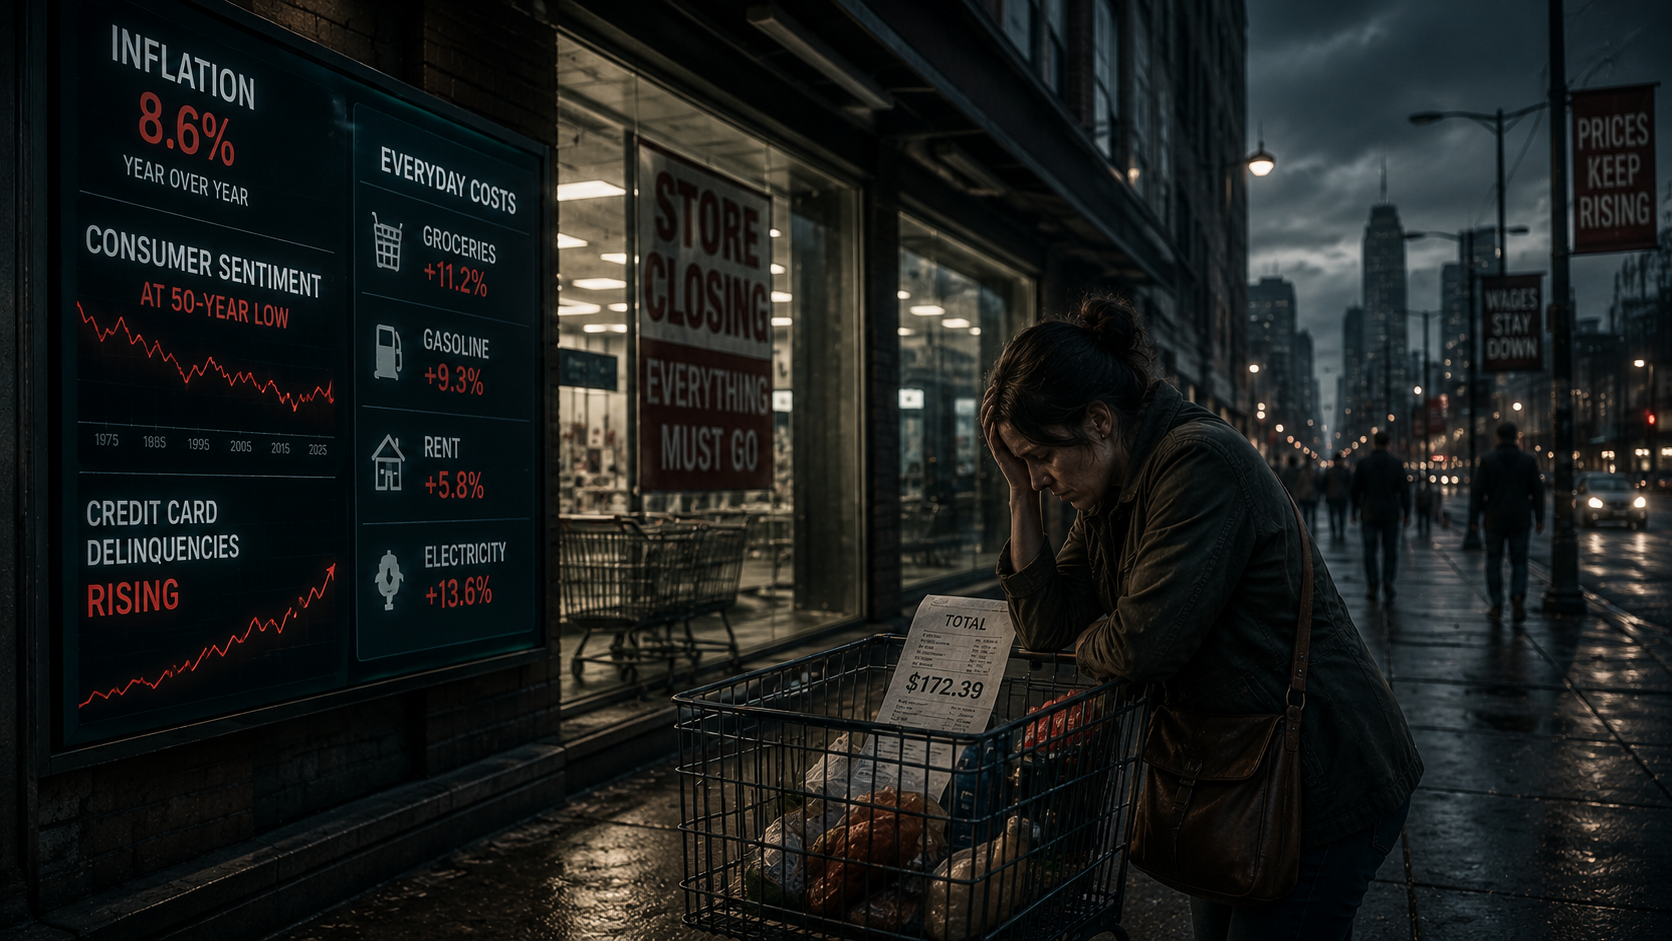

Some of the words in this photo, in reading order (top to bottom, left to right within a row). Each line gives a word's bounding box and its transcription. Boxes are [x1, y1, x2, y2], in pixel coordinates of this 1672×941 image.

[111, 24, 255, 110] INFLATION
[139, 91, 235, 166] 8.6%
[1577, 112, 1649, 150] PRICES
[123, 154, 164, 185] YEAR
[170, 168, 208, 196] OVER
[213, 180, 249, 207] YEAR
[381, 146, 466, 197] EVERYDAY
[470, 179, 516, 215] COSTS
[1587, 153, 1640, 190] KEEP
[655, 170, 760, 270] STORE
[1579, 191, 1650, 230] RISING
[86, 224, 212, 277] CONSUMER
[219, 254, 322, 298] SENTIMENT
[423, 226, 496, 264] GROCERIES
[424, 261, 488, 297] +11.2%
[140, 281, 165, 308] AT
[171, 287, 249, 323] 50-YEAR
[254, 302, 289, 329] LOW
[644, 252, 768, 344] CLOSING
[1485, 288, 1538, 311] WAGES
[1492, 312, 1531, 336] STAY
[423, 328, 489, 359] GASOLINE
[1487, 337, 1537, 361] DOWN
[424, 363, 484, 396] +9.3%
[646, 357, 768, 416] EVERYTHING
[95, 433, 119, 447] 1975
[187, 438, 210, 450] 1995
[230, 440, 252, 452] 2005
[271, 442, 290, 454] 2015
[309, 444, 327, 456] 2025
[424, 435, 460, 459] RENT
[661, 424, 724, 472] MUST
[731, 428, 758, 472] GO
[425, 471, 484, 499] +5.8%
[86, 500, 161, 526] CREDIT
[167, 500, 217, 524] CARD
[87, 534, 240, 566] DELINQUENCIES
[425, 542, 506, 568] ELECTRICITY
[88, 578, 179, 617] RISING
[425, 575, 492, 608] +13.6%
[945, 614, 986, 631] TOTAL
[905, 671, 984, 699] $172.39
